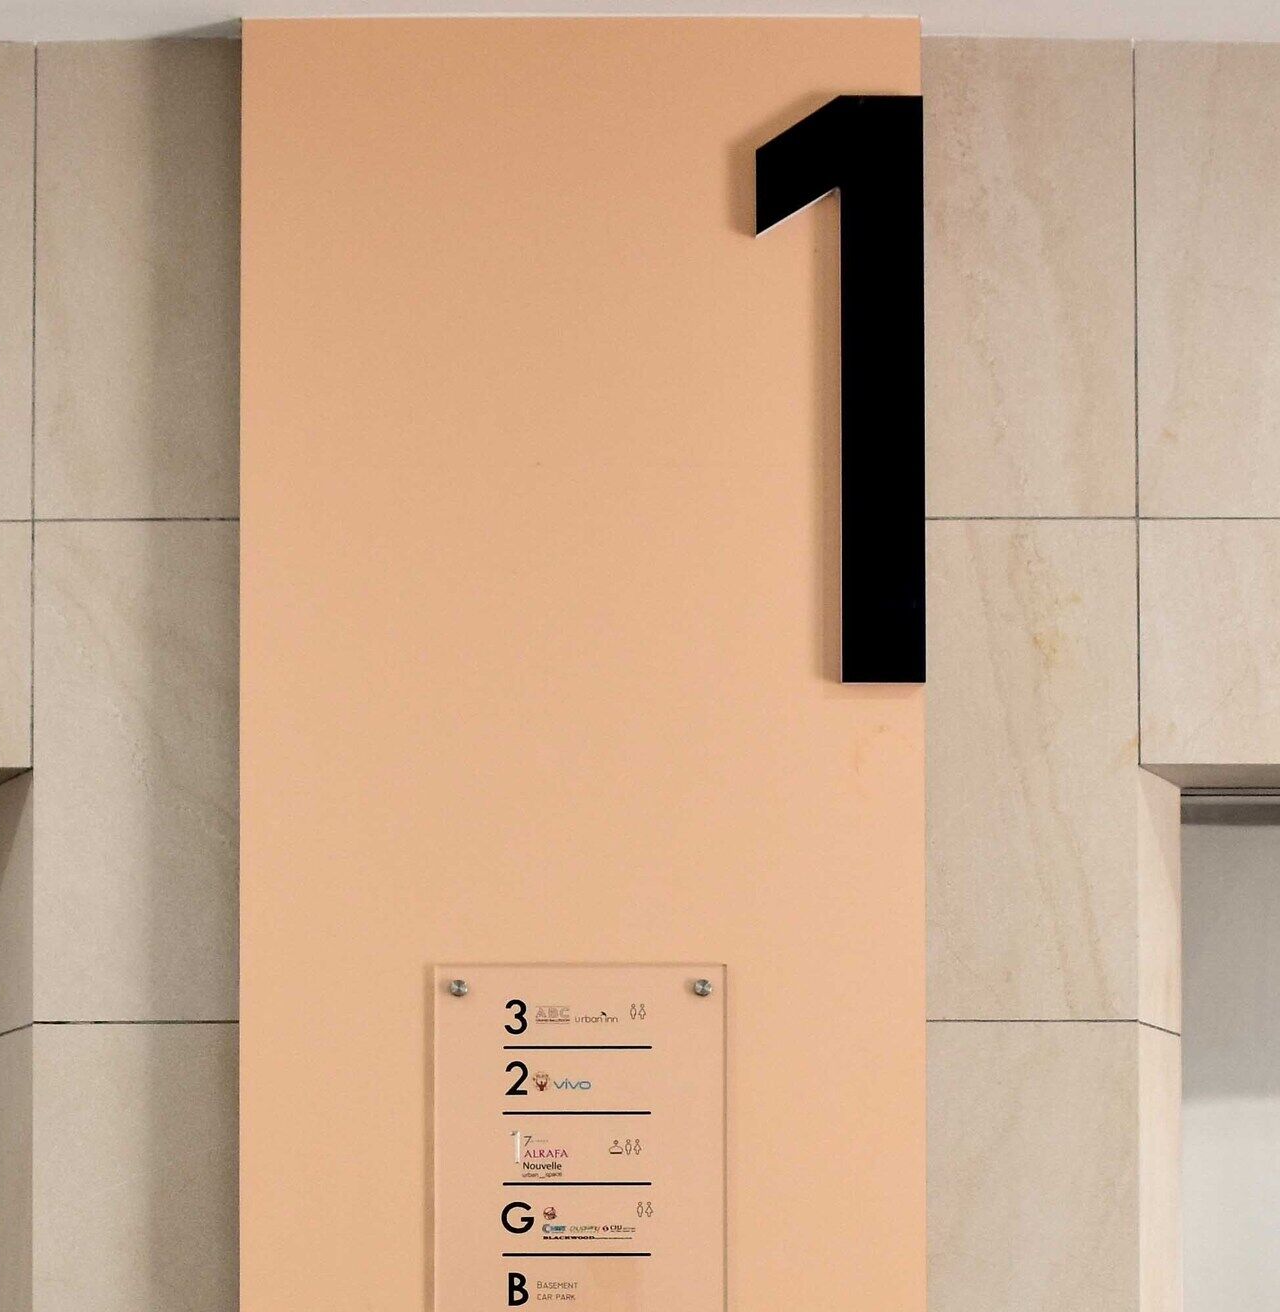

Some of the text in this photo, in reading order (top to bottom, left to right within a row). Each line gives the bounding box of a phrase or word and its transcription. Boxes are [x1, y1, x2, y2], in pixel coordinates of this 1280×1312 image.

[756, 95, 926, 683] 1
[504, 999, 528, 1035] 3
[505, 1060, 528, 1096] 2
[553, 1078, 592, 1090] vivo
[523, 1162, 563, 1170] Nouvelle
[524, 1149, 569, 1158] ALRAFA
[501, 1201, 535, 1234] G
[508, 1272, 529, 1306] B
